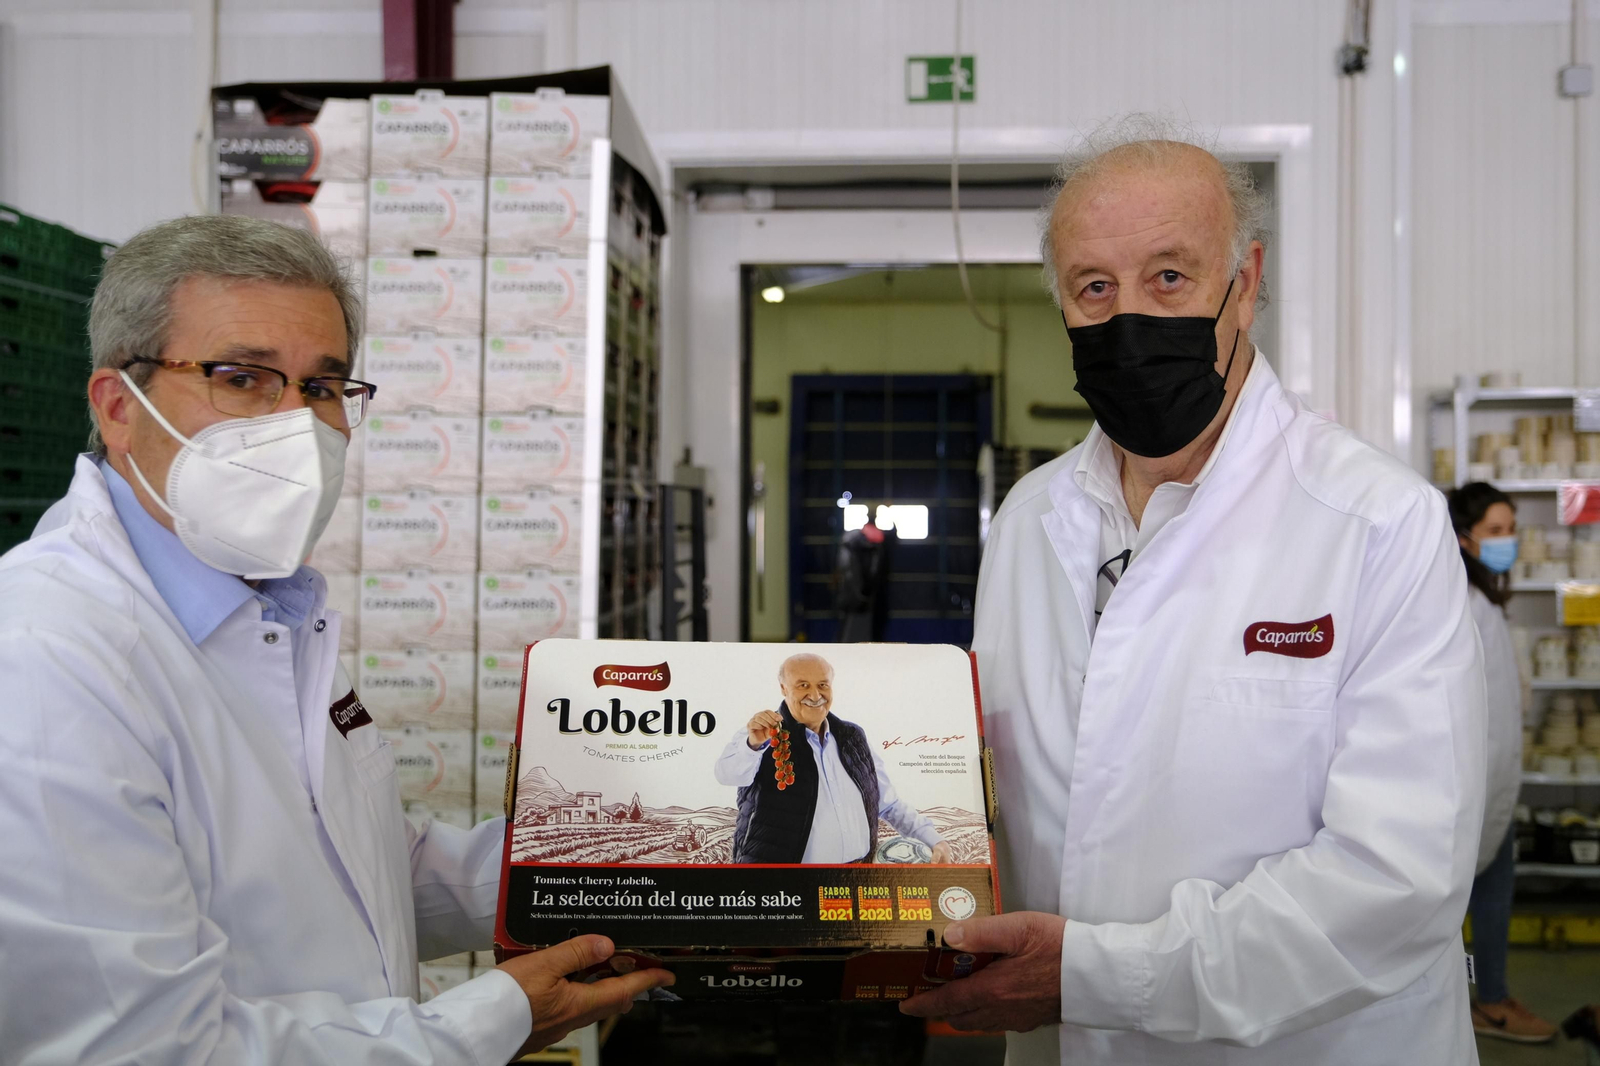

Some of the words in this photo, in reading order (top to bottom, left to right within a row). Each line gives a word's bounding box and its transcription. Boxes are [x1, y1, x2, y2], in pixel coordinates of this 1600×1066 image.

[335, 697, 363, 725] Caparró
[547, 698, 717, 737] Lobello
[583, 746, 636, 763] TOMATES
[639, 747, 684, 763] CHERRY
[533, 875, 577, 885] Tomates
[578, 876, 614, 886] Cherry
[616, 876, 657, 886] Lobello.
[824, 886, 850, 896] SABOR
[863, 886, 890, 896] SABOR
[902, 886, 929, 896] SABOR
[532, 890, 554, 906] La
[558, 889, 644, 907] selección
[648, 890, 676, 907] del
[680, 894, 715, 910] que
[718, 890, 756, 907] más
[761, 890, 802, 907] sabe
[819, 908, 853, 921] 2021
[859, 908, 893, 921] 2020
[899, 908, 932, 921] 2019
[700, 975, 803, 987] Lobello
